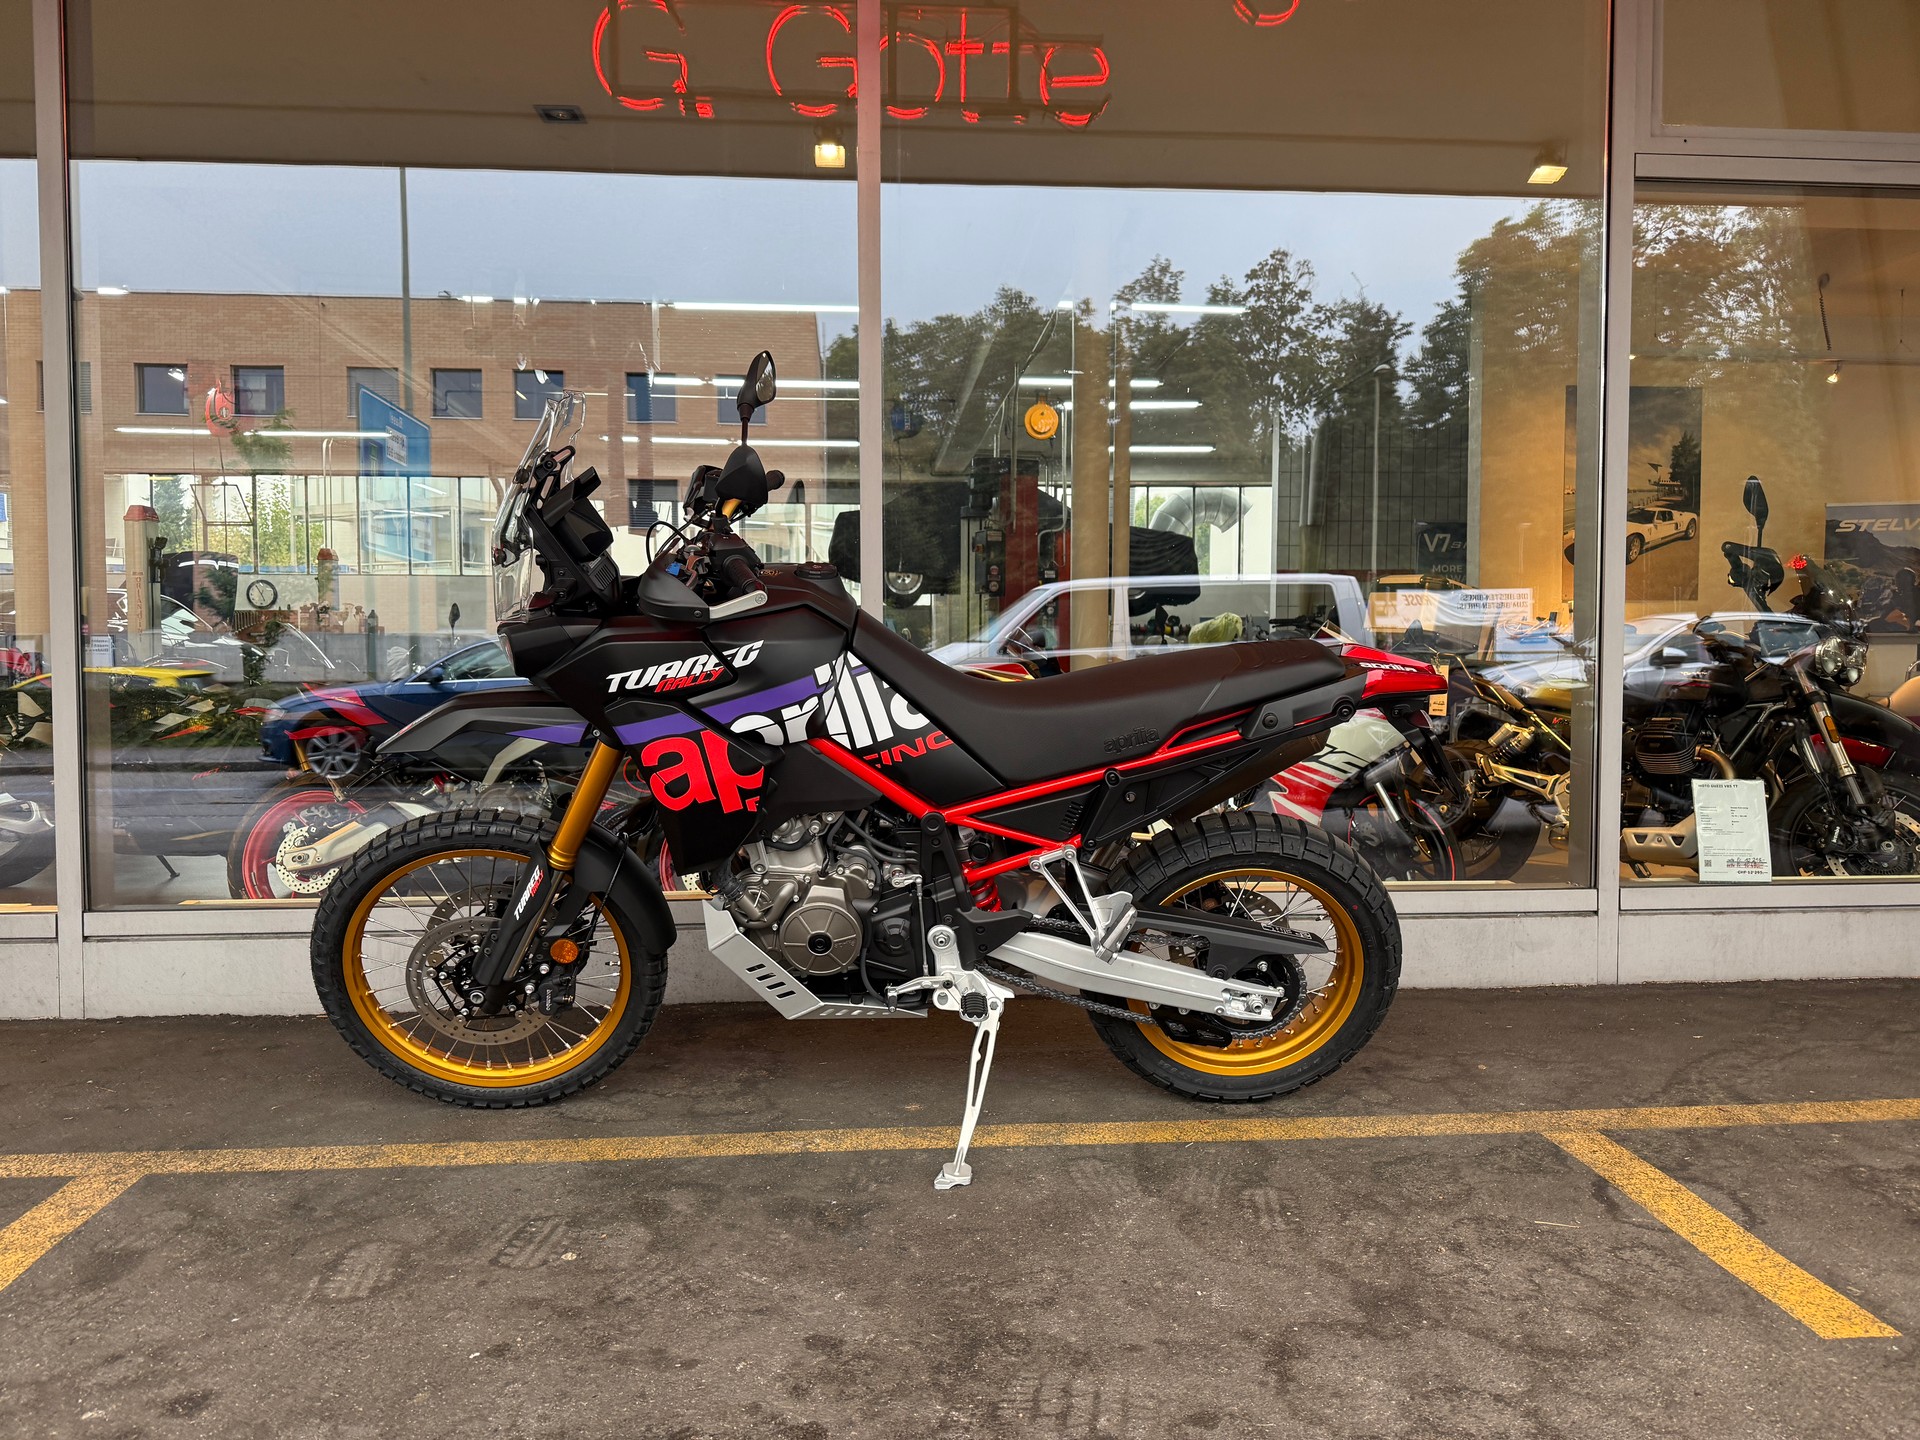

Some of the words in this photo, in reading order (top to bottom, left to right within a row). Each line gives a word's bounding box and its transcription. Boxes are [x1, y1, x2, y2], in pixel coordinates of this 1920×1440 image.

[1423, 533, 1451, 552] V7
[1432, 564, 1463, 573] MORE
[606, 640, 765, 693] TUAREG
[1359, 662, 1418, 673] aprilia
[654, 667, 725, 693] RALLY
[1103, 726, 1160, 755] aprilia
